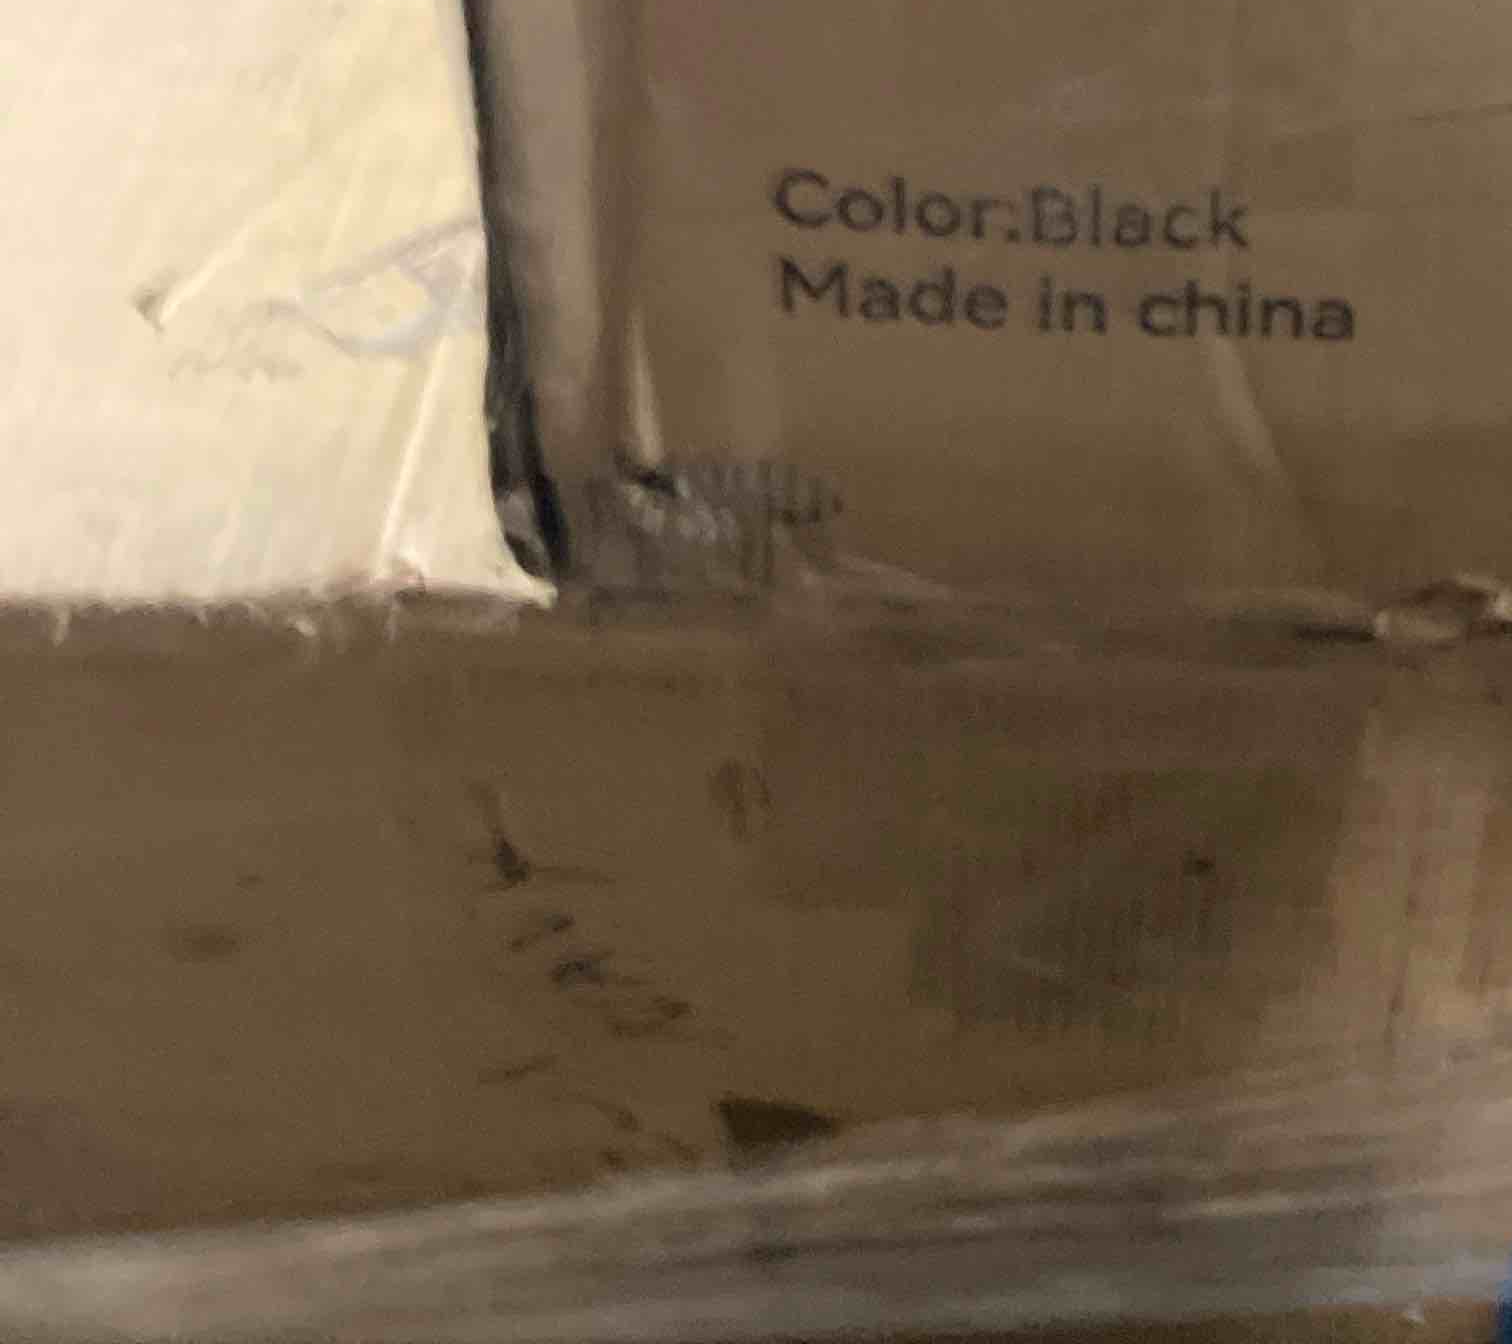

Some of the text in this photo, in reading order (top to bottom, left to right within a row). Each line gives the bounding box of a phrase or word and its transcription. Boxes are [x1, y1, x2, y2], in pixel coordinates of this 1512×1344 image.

[777, 254, 1358, 342] Made in china
